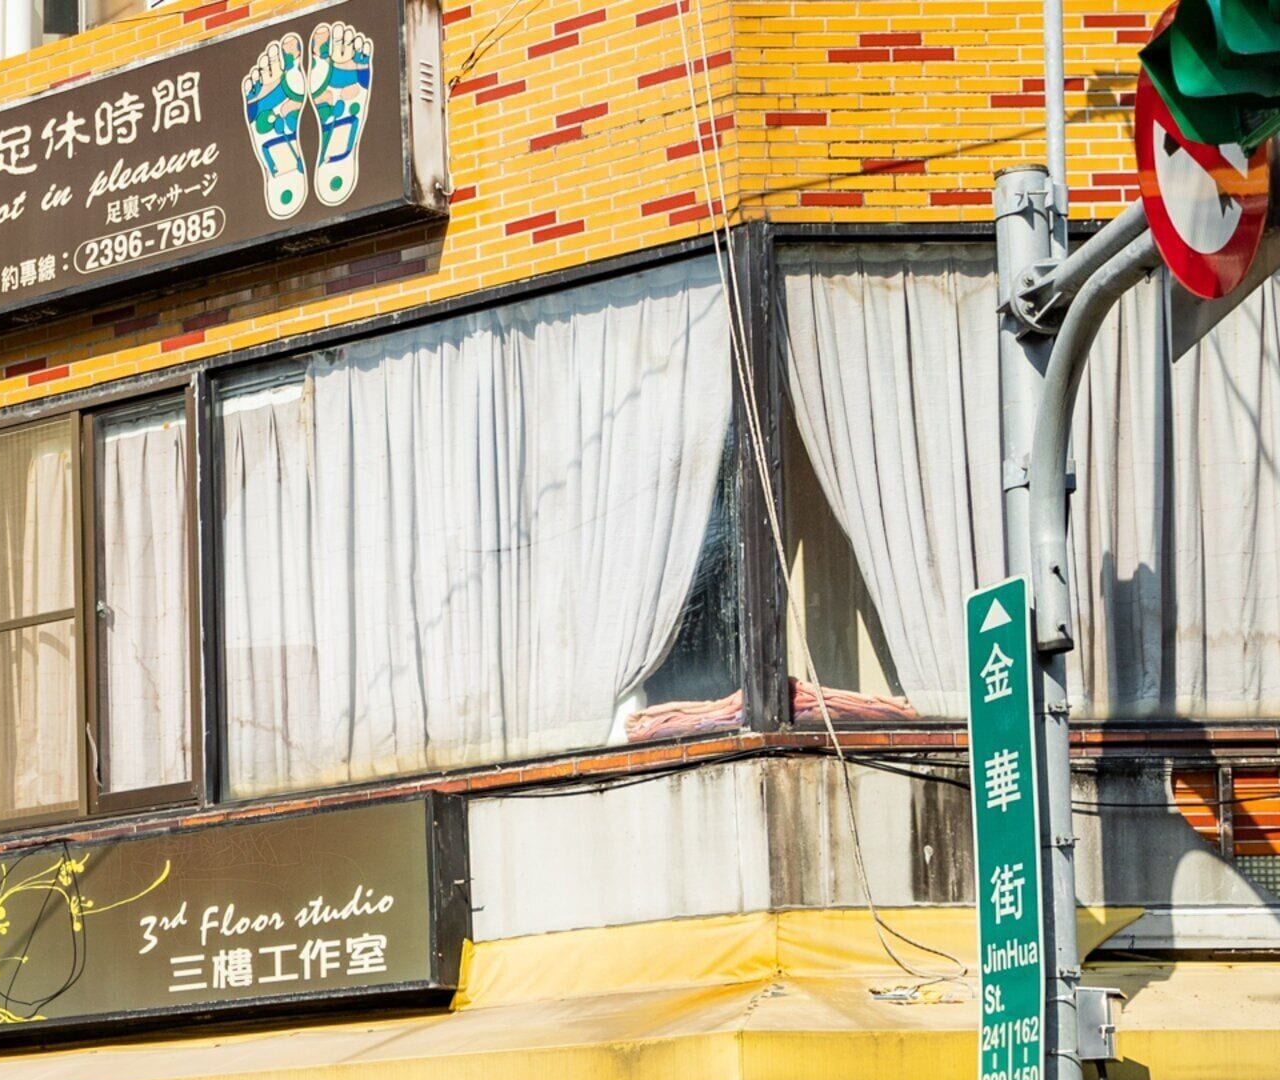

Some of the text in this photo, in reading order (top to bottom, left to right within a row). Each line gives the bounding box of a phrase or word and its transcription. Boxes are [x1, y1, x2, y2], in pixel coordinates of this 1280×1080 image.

[41, 184, 72, 211] in
[86, 143, 220, 208] pleasure
[85, 210, 216, 270] 2396-7985
[980, 643, 1026, 924] 金華街
[139, 885, 394, 954] 3rd Floor studio
[169, 932, 388, 992] 三樓工作室
[983, 938, 1039, 974] JinHua
[984, 984, 1005, 1014] St.
[982, 1016, 1039, 1050] 241 162
